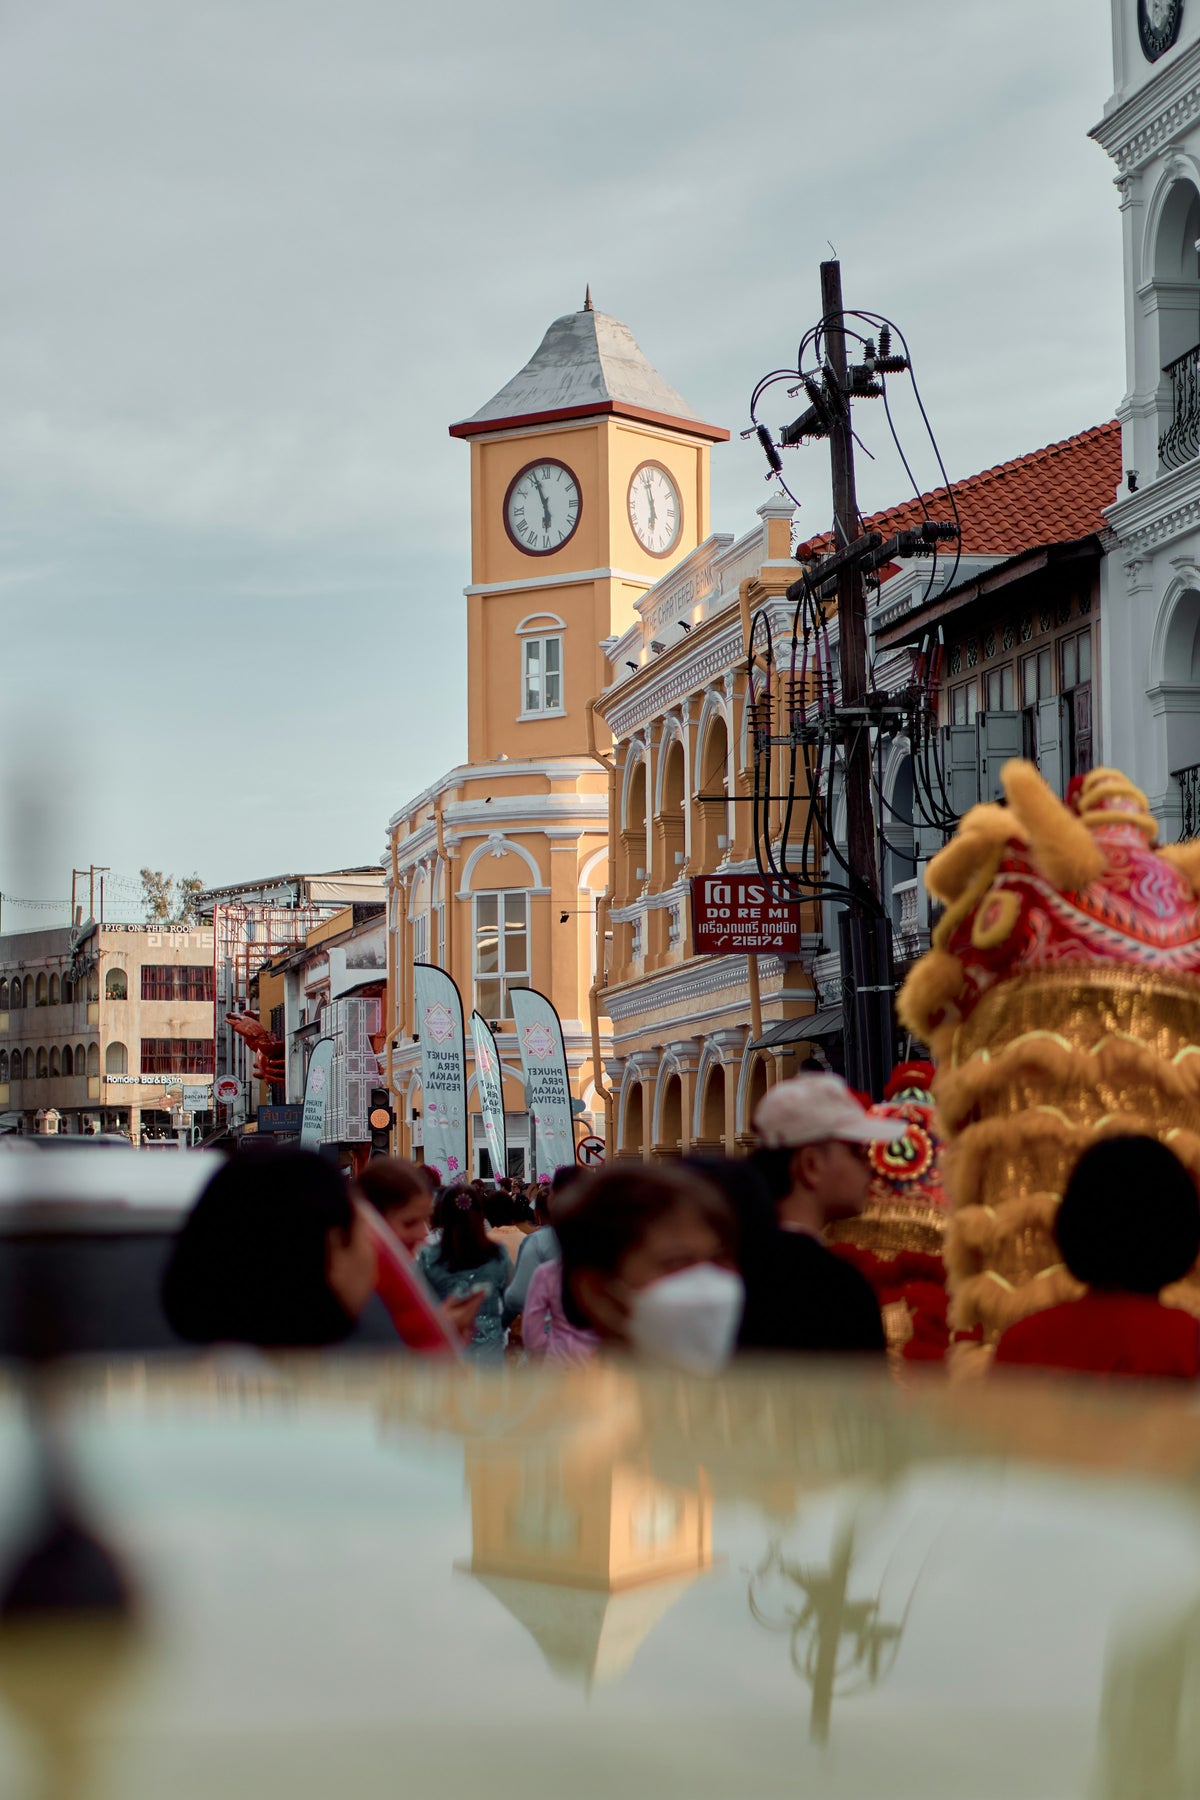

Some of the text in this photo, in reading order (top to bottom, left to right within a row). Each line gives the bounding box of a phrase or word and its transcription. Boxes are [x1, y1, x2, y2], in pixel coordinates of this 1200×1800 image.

[658, 580, 694, 625] CHARTERED
[695, 565, 713, 595] BANK
[704, 880, 731, 904] โด
[706, 908, 789, 918] DO RE MI
[105, 924, 195, 933] PIG ON THE ROOF
[698, 920, 759, 934] เครื่องดนตรี
[732, 936, 784, 946] 215174
[107, 1075, 140, 1084] Romdee
[161, 1075, 183, 1084] Bistro
[305, 1100, 323, 1108] PHUKET
